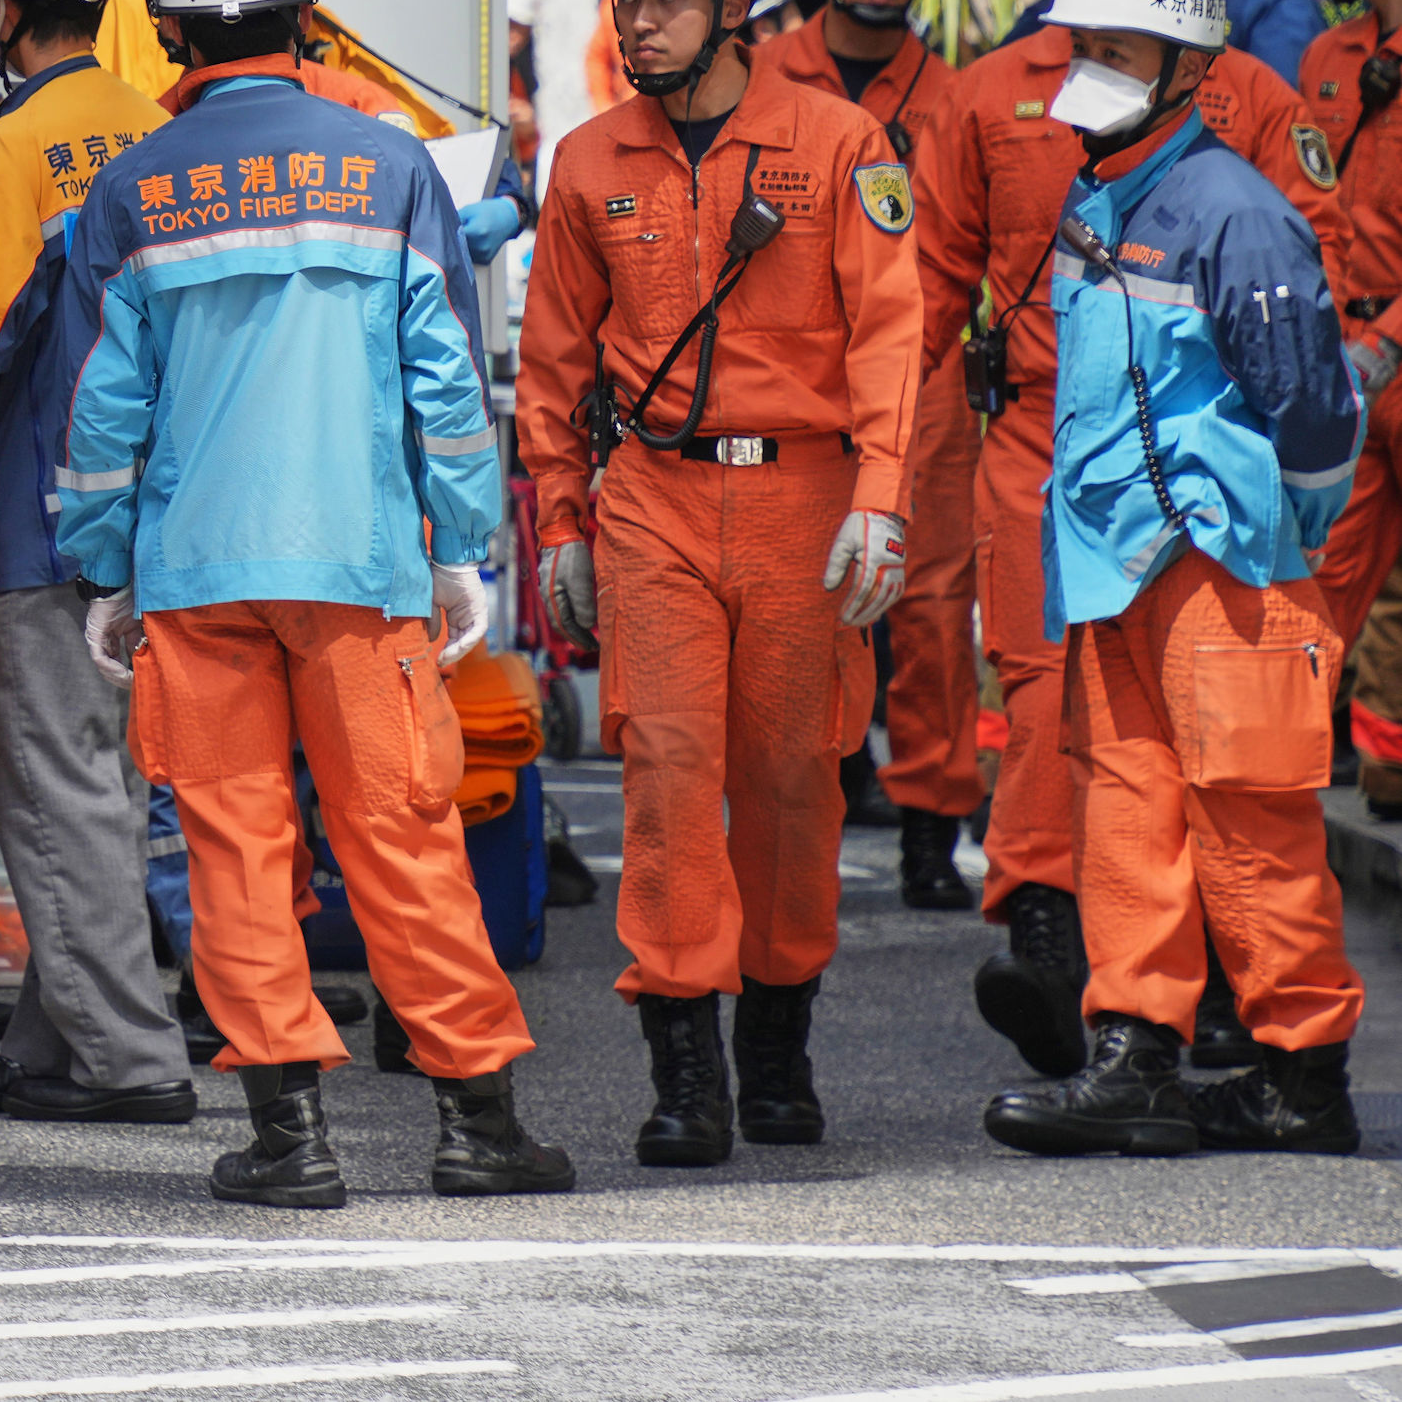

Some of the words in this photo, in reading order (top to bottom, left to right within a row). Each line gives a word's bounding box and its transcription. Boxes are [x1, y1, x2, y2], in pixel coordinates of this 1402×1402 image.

[44, 131, 149, 178] 東京
[758, 170, 812, 182] 東京消防庁
[136, 151, 377, 212] 東京消防庁
[142, 202, 230, 235] TOKYO
[239, 193, 298, 219] FIRE
[305, 190, 376, 217] DEPT.
